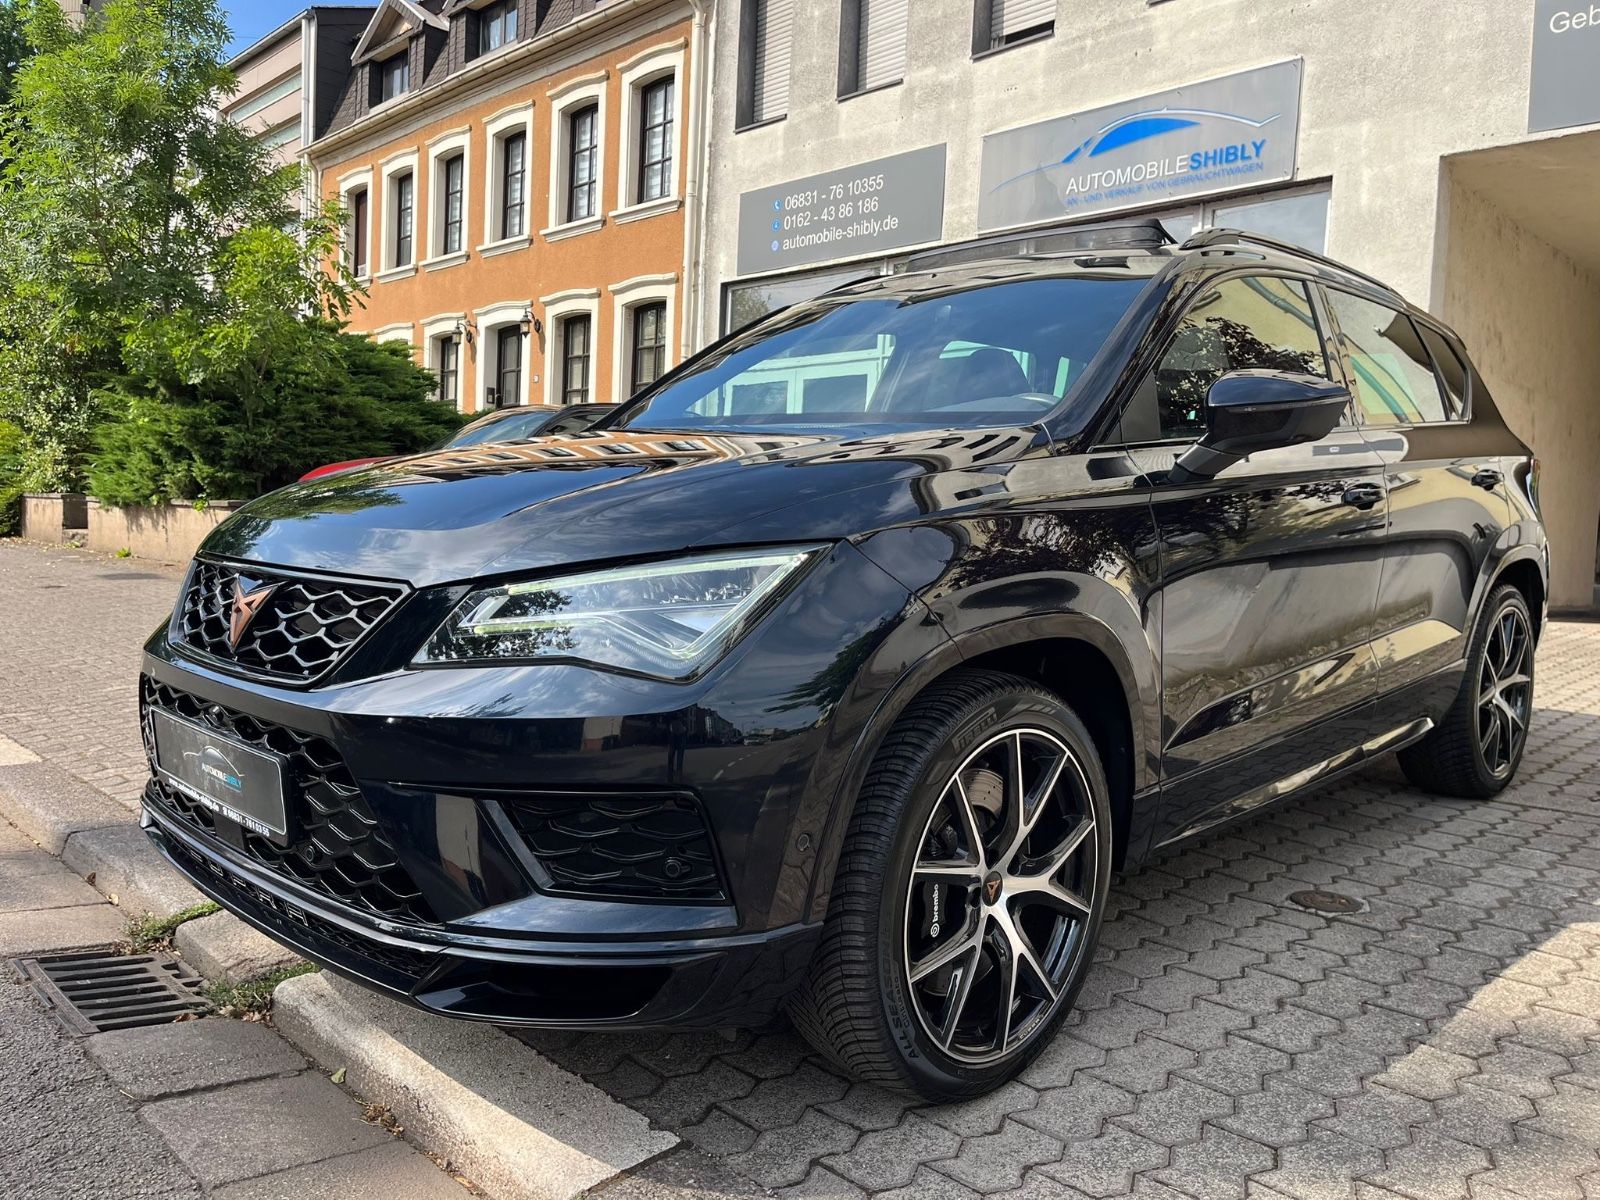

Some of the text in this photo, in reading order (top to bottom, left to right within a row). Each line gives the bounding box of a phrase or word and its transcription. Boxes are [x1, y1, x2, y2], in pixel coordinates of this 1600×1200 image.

[784, 190, 818, 210] 06831
[829, 184, 844, 200] 76
[847, 174, 884, 195] 10355
[1146, 180, 1165, 192] VON
[1167, 162, 1265, 188] GEBRAUCHTWAGEN
[784, 210, 810, 230] 0162
[821, 205, 835, 221] 43
[839, 201, 853, 218] 86
[857, 196, 879, 214] 186
[783, 214, 899, 250] automobile-shibly.de
